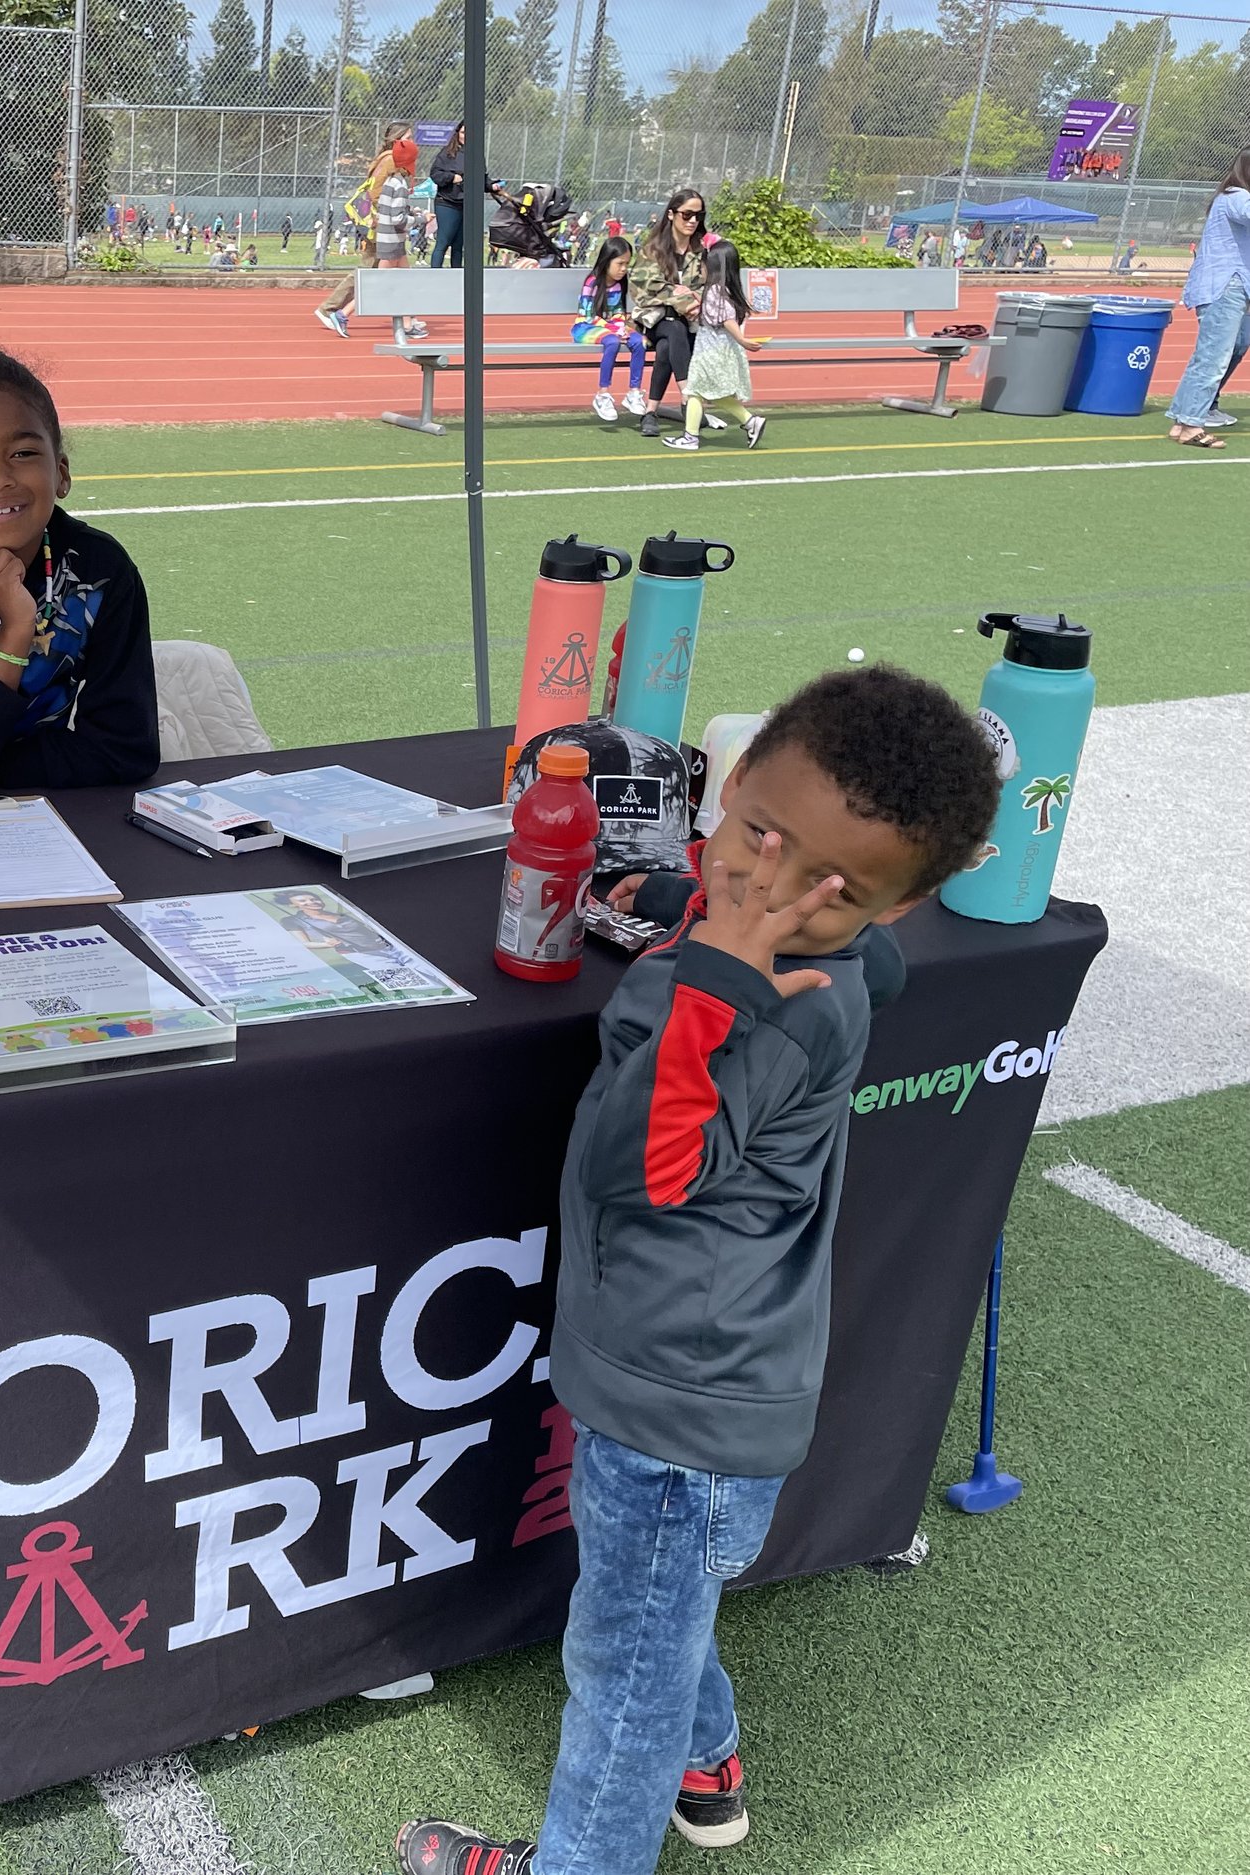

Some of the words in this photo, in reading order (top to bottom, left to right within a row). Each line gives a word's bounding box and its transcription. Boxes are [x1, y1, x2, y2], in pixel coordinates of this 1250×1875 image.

[544, 656, 556, 664] 19
[537, 686, 573, 696] CORICA
[139, 801, 158, 815] STAPLES
[600, 806, 635, 814] CORICA
[637, 807, 657, 815] PARK
[1012, 840, 1040, 907] Hydrology
[39, 934, 58, 942] A
[850, 1025, 1067, 1115] enwayGolf
[512, 1468, 574, 1548] 2
